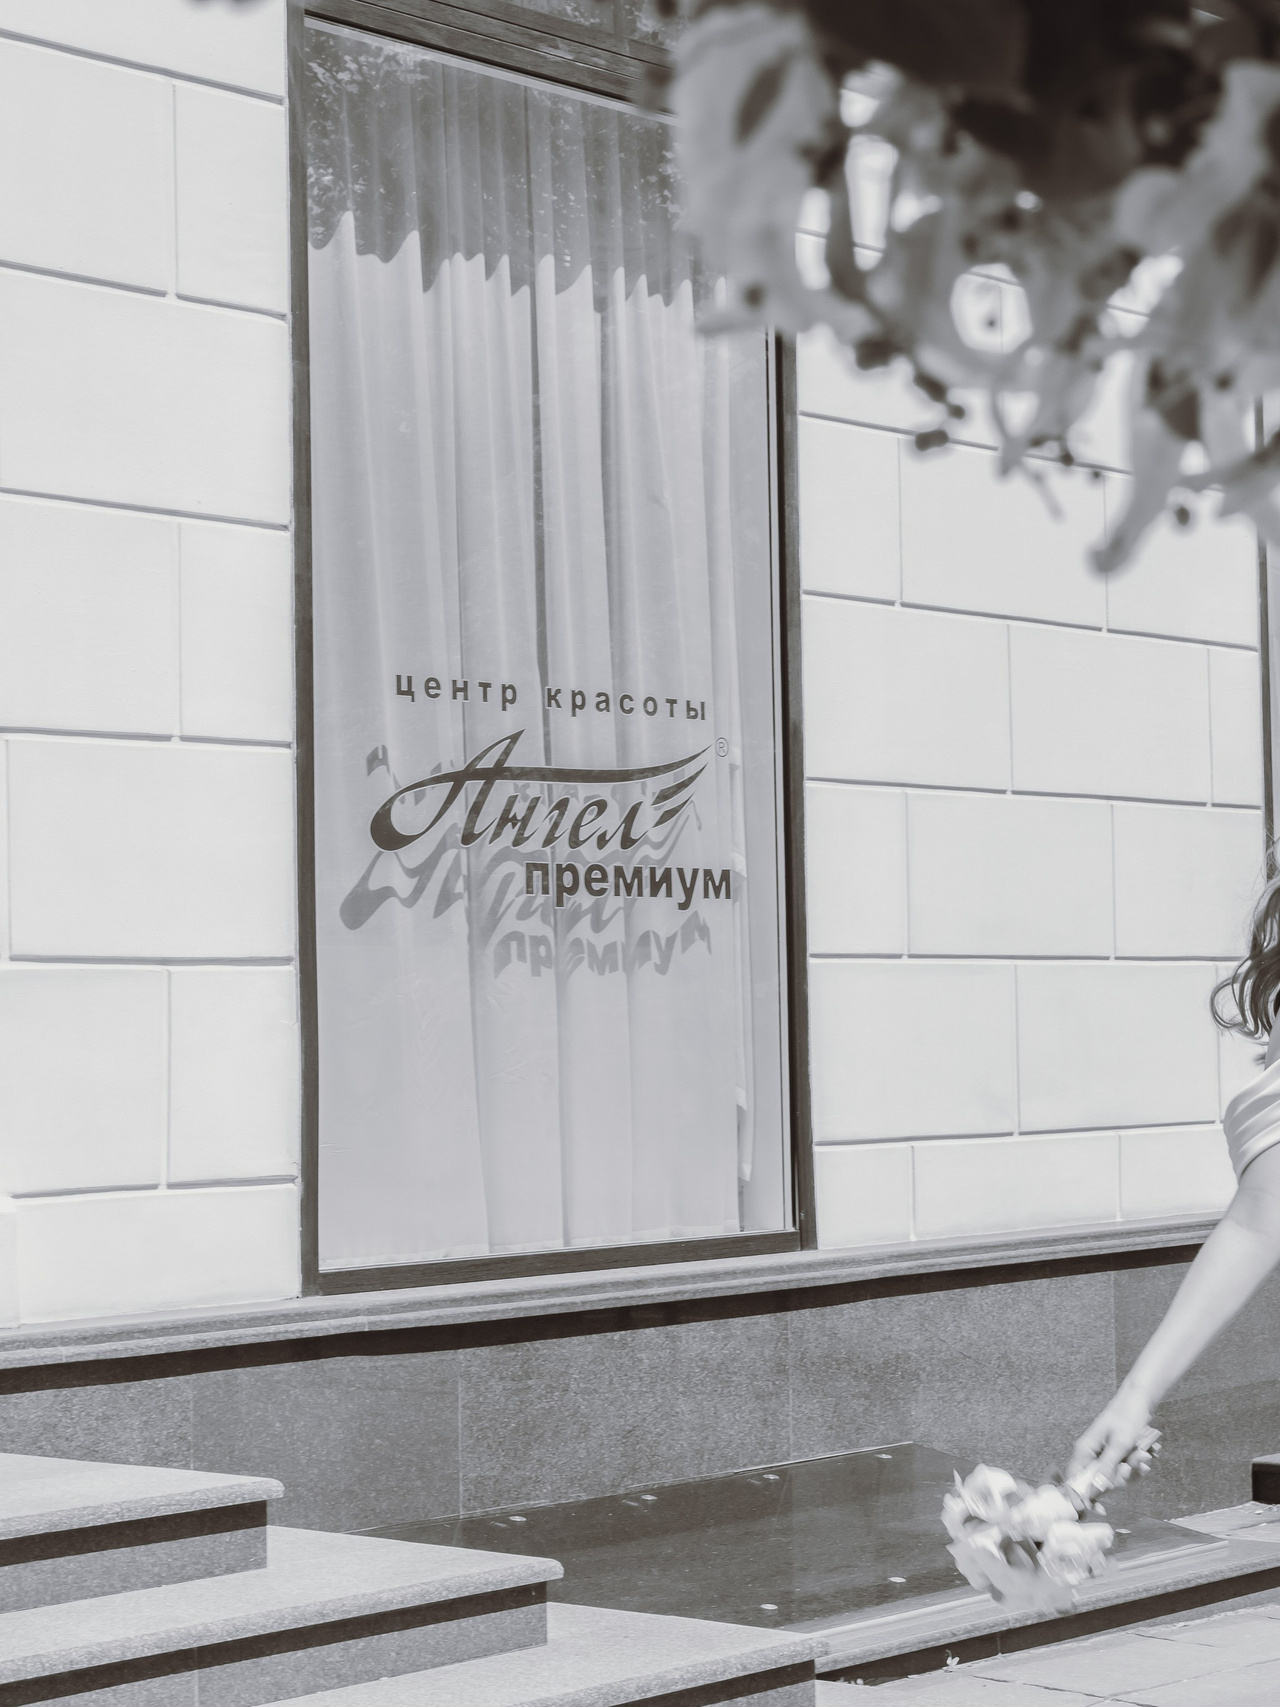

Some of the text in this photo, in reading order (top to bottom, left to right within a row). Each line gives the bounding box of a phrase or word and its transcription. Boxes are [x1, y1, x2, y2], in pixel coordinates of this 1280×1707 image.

[395, 674, 707, 721] центр красоты
[370, 728, 714, 852] Ангел
[524, 860, 733, 911] премиум
